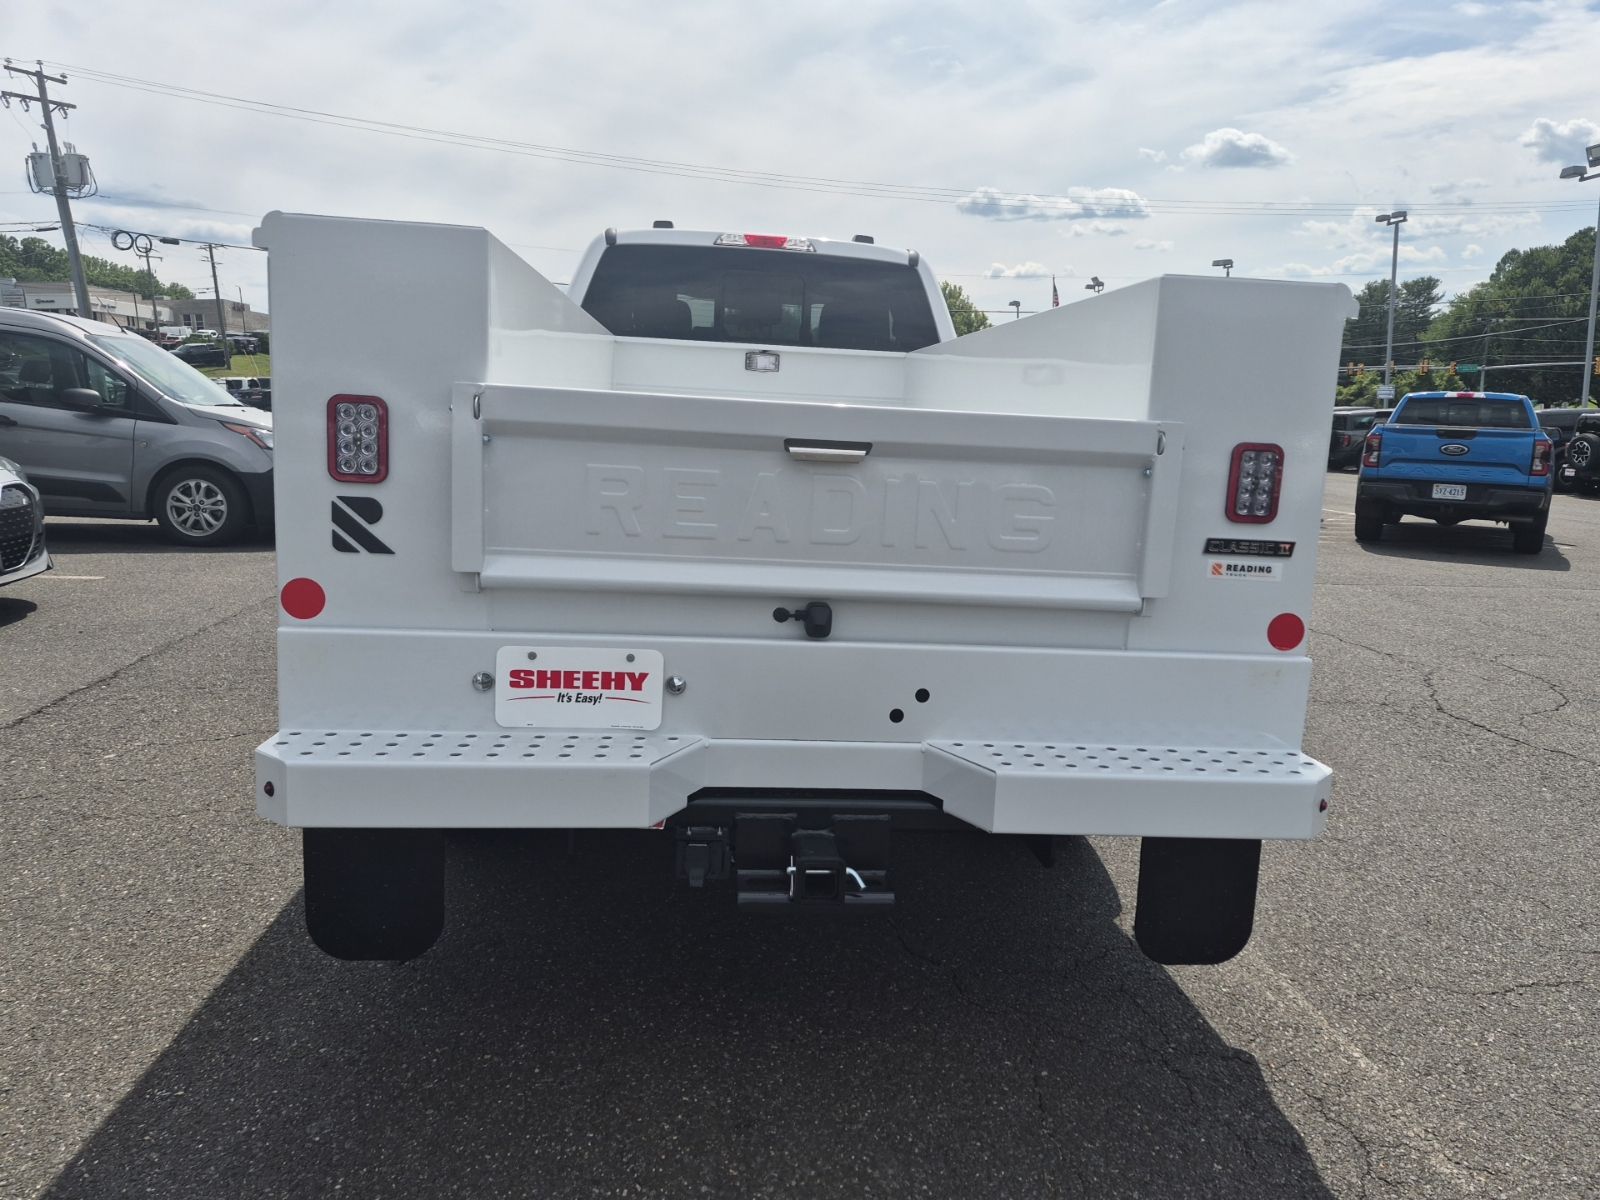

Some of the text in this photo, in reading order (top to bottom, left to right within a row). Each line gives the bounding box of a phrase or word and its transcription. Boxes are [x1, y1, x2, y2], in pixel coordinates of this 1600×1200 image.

[585, 463, 1056, 553] READING
[1226, 564, 1272, 574] READING
[509, 669, 649, 691] SHEEHY
[557, 692, 603, 705] It's Easy!
